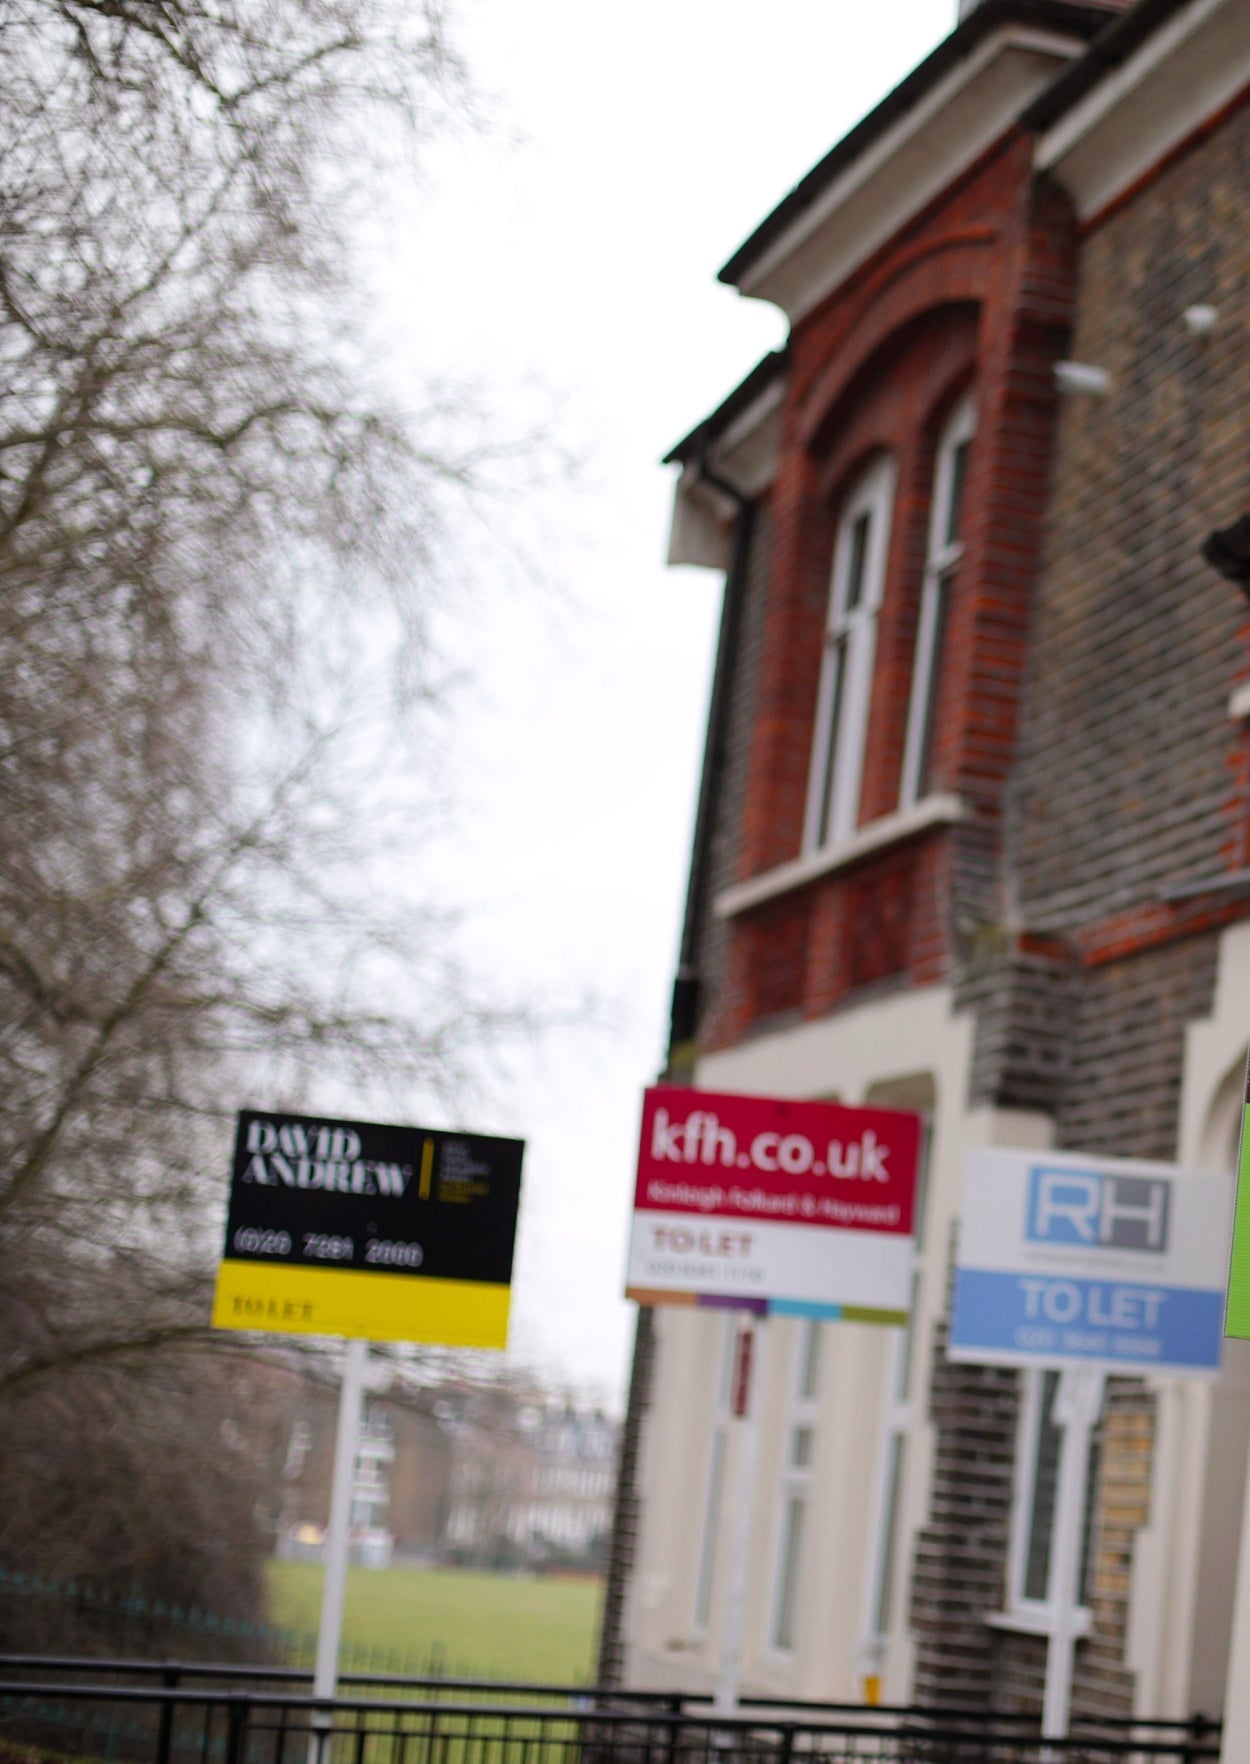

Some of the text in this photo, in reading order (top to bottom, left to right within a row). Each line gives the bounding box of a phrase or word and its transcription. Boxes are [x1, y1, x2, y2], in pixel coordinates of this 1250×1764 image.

[246, 1119, 362, 1163] DAVID
[650, 1106, 891, 1184] kfh.co.uk
[242, 1153, 414, 1198] ANDREW
[1034, 1171, 1166, 1248] RH
[652, 1227, 755, 1258] TO LET
[1017, 1277, 1168, 1331] TO LET
